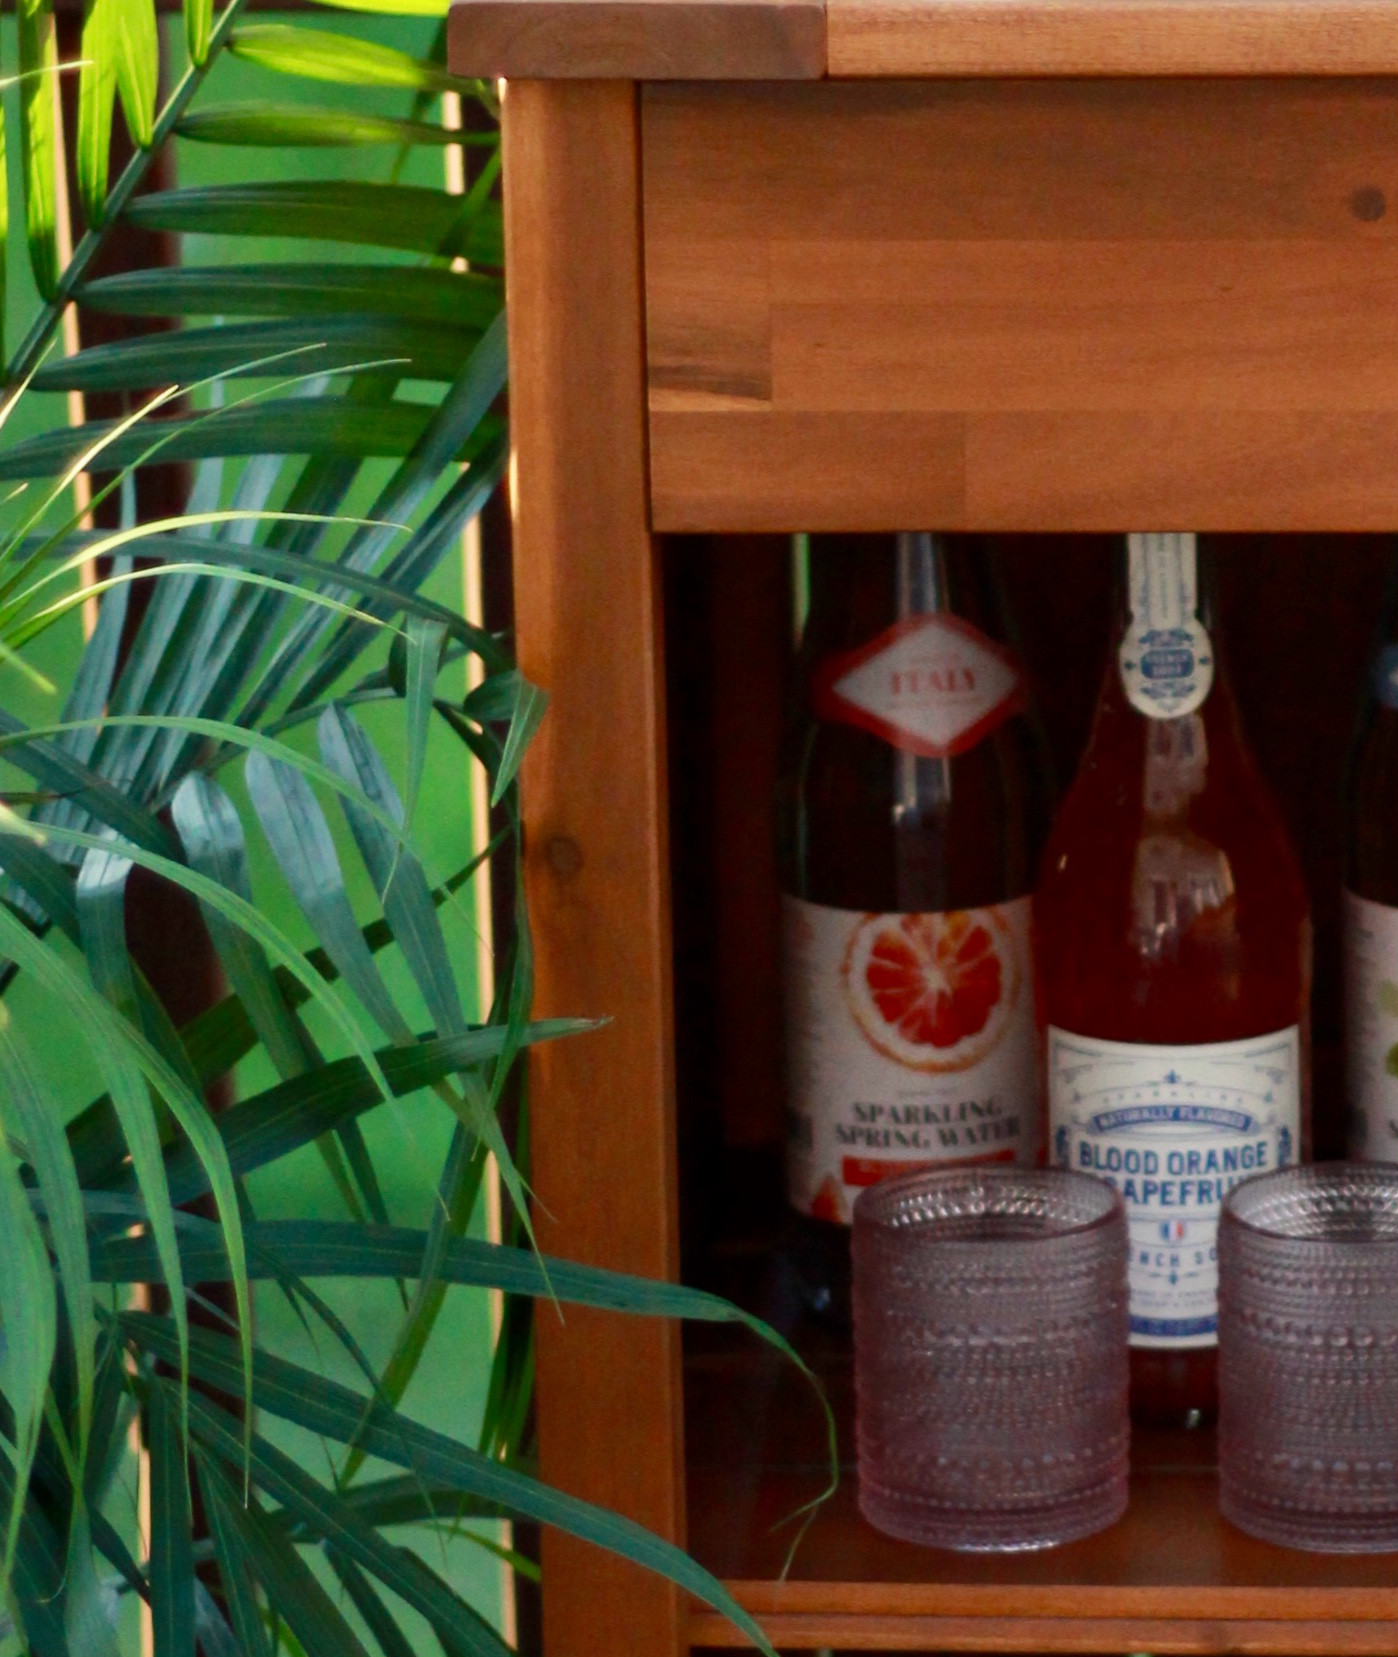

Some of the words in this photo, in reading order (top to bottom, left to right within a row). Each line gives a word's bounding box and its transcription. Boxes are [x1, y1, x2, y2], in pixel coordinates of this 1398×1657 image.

[890, 667, 976, 695] ITALY
[853, 1101, 1002, 1124] SPARKLING
[836, 1124, 929, 1148] SPRING
[1079, 1141, 1159, 1175] BLOOD
[1166, 1141, 1268, 1176] ORANGE
